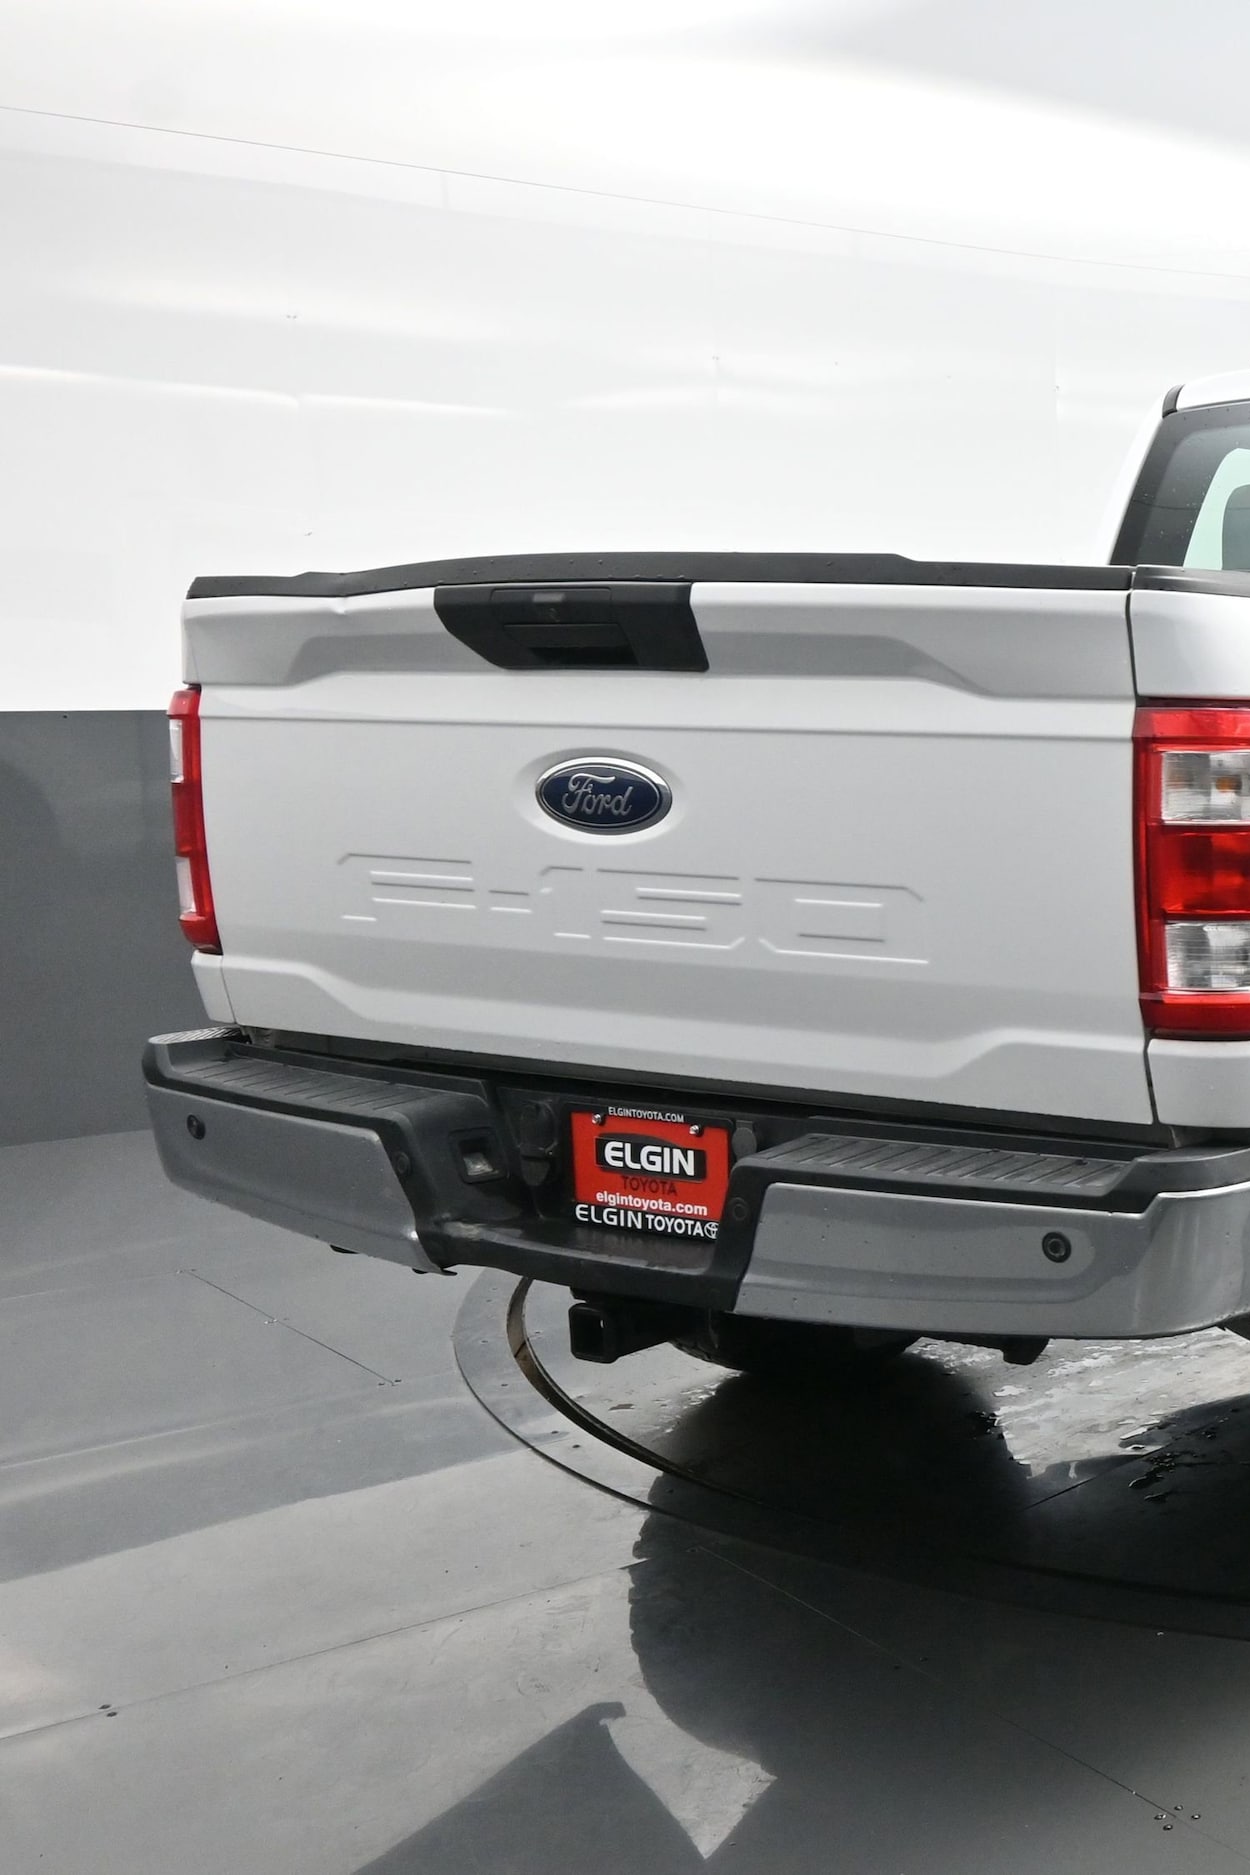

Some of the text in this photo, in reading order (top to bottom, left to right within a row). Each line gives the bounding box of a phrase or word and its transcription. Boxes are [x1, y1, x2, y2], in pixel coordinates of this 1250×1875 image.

[560, 772, 633, 818] Ford
[337, 852, 930, 965] F-150
[608, 1107, 684, 1122] ELGINTOYOTA.COM
[604, 1141, 695, 1176] ELGIN
[597, 1191, 707, 1216] elgintoyota.com
[623, 1177, 676, 1195] TOYOTA
[575, 1203, 705, 1238] ELGIN TOYOTA
